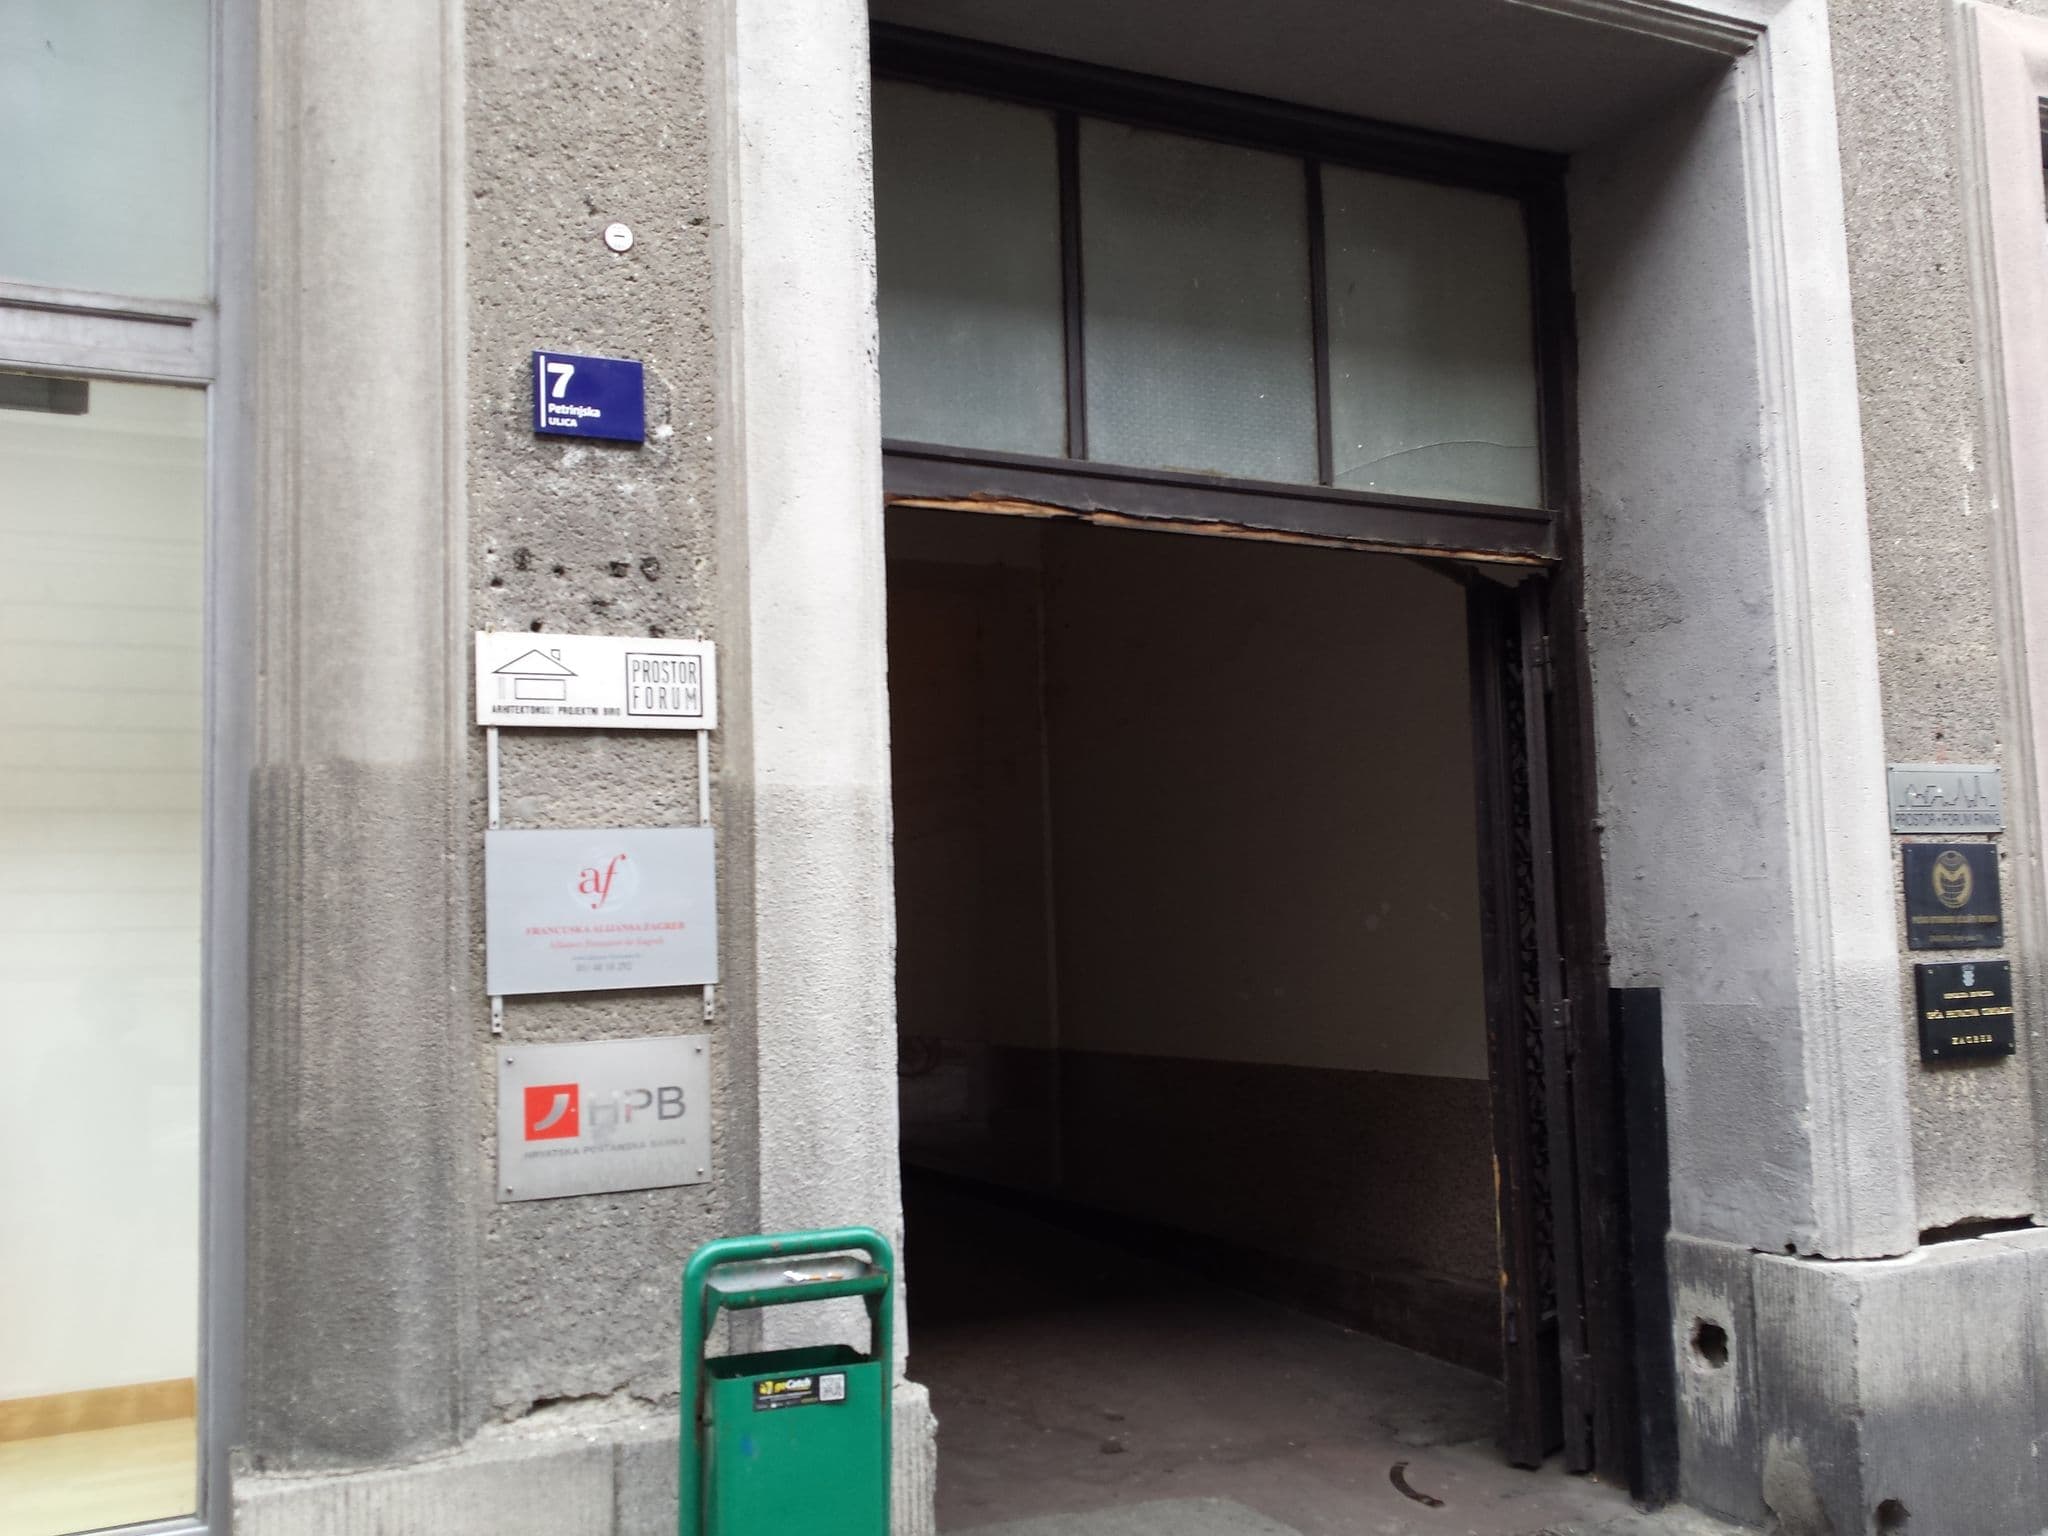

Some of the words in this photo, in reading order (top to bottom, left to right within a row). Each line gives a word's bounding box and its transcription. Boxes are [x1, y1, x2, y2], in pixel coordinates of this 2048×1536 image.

[547, 362, 575, 398] 7
[548, 403, 601, 418] Petrinjska
[548, 417, 578, 427] ULICA
[632, 660, 697, 684] PROSTOR
[632, 686, 697, 711] FORUM
[578, 853, 627, 909] af
